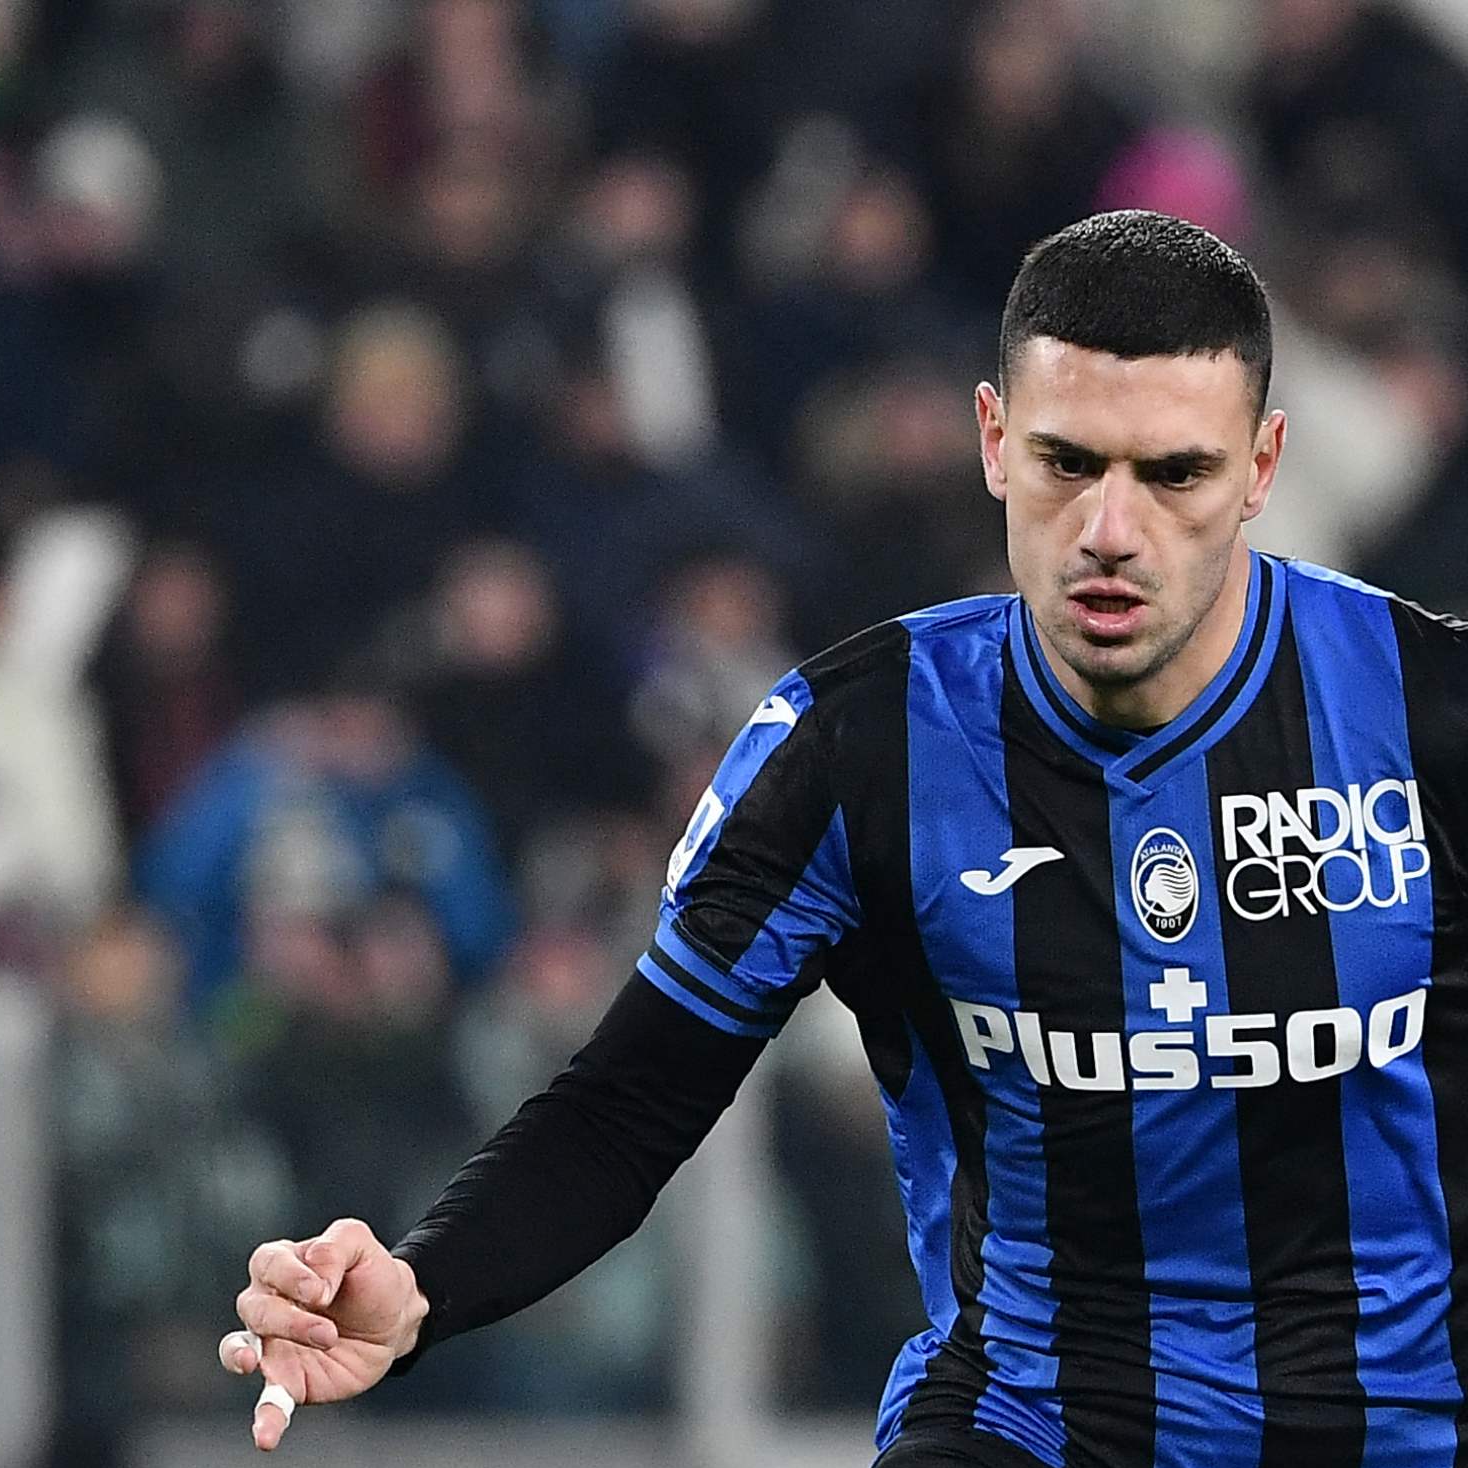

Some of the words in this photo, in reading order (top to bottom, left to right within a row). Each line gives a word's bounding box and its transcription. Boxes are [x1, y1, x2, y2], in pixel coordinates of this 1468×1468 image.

[1140, 844, 1184, 862] ATALANTA
[1220, 778, 1426, 861] RADICI
[1226, 842, 1431, 921] GROUP
[1155, 916, 1182, 930] 1907
[949, 988, 1427, 1092] Plus500
